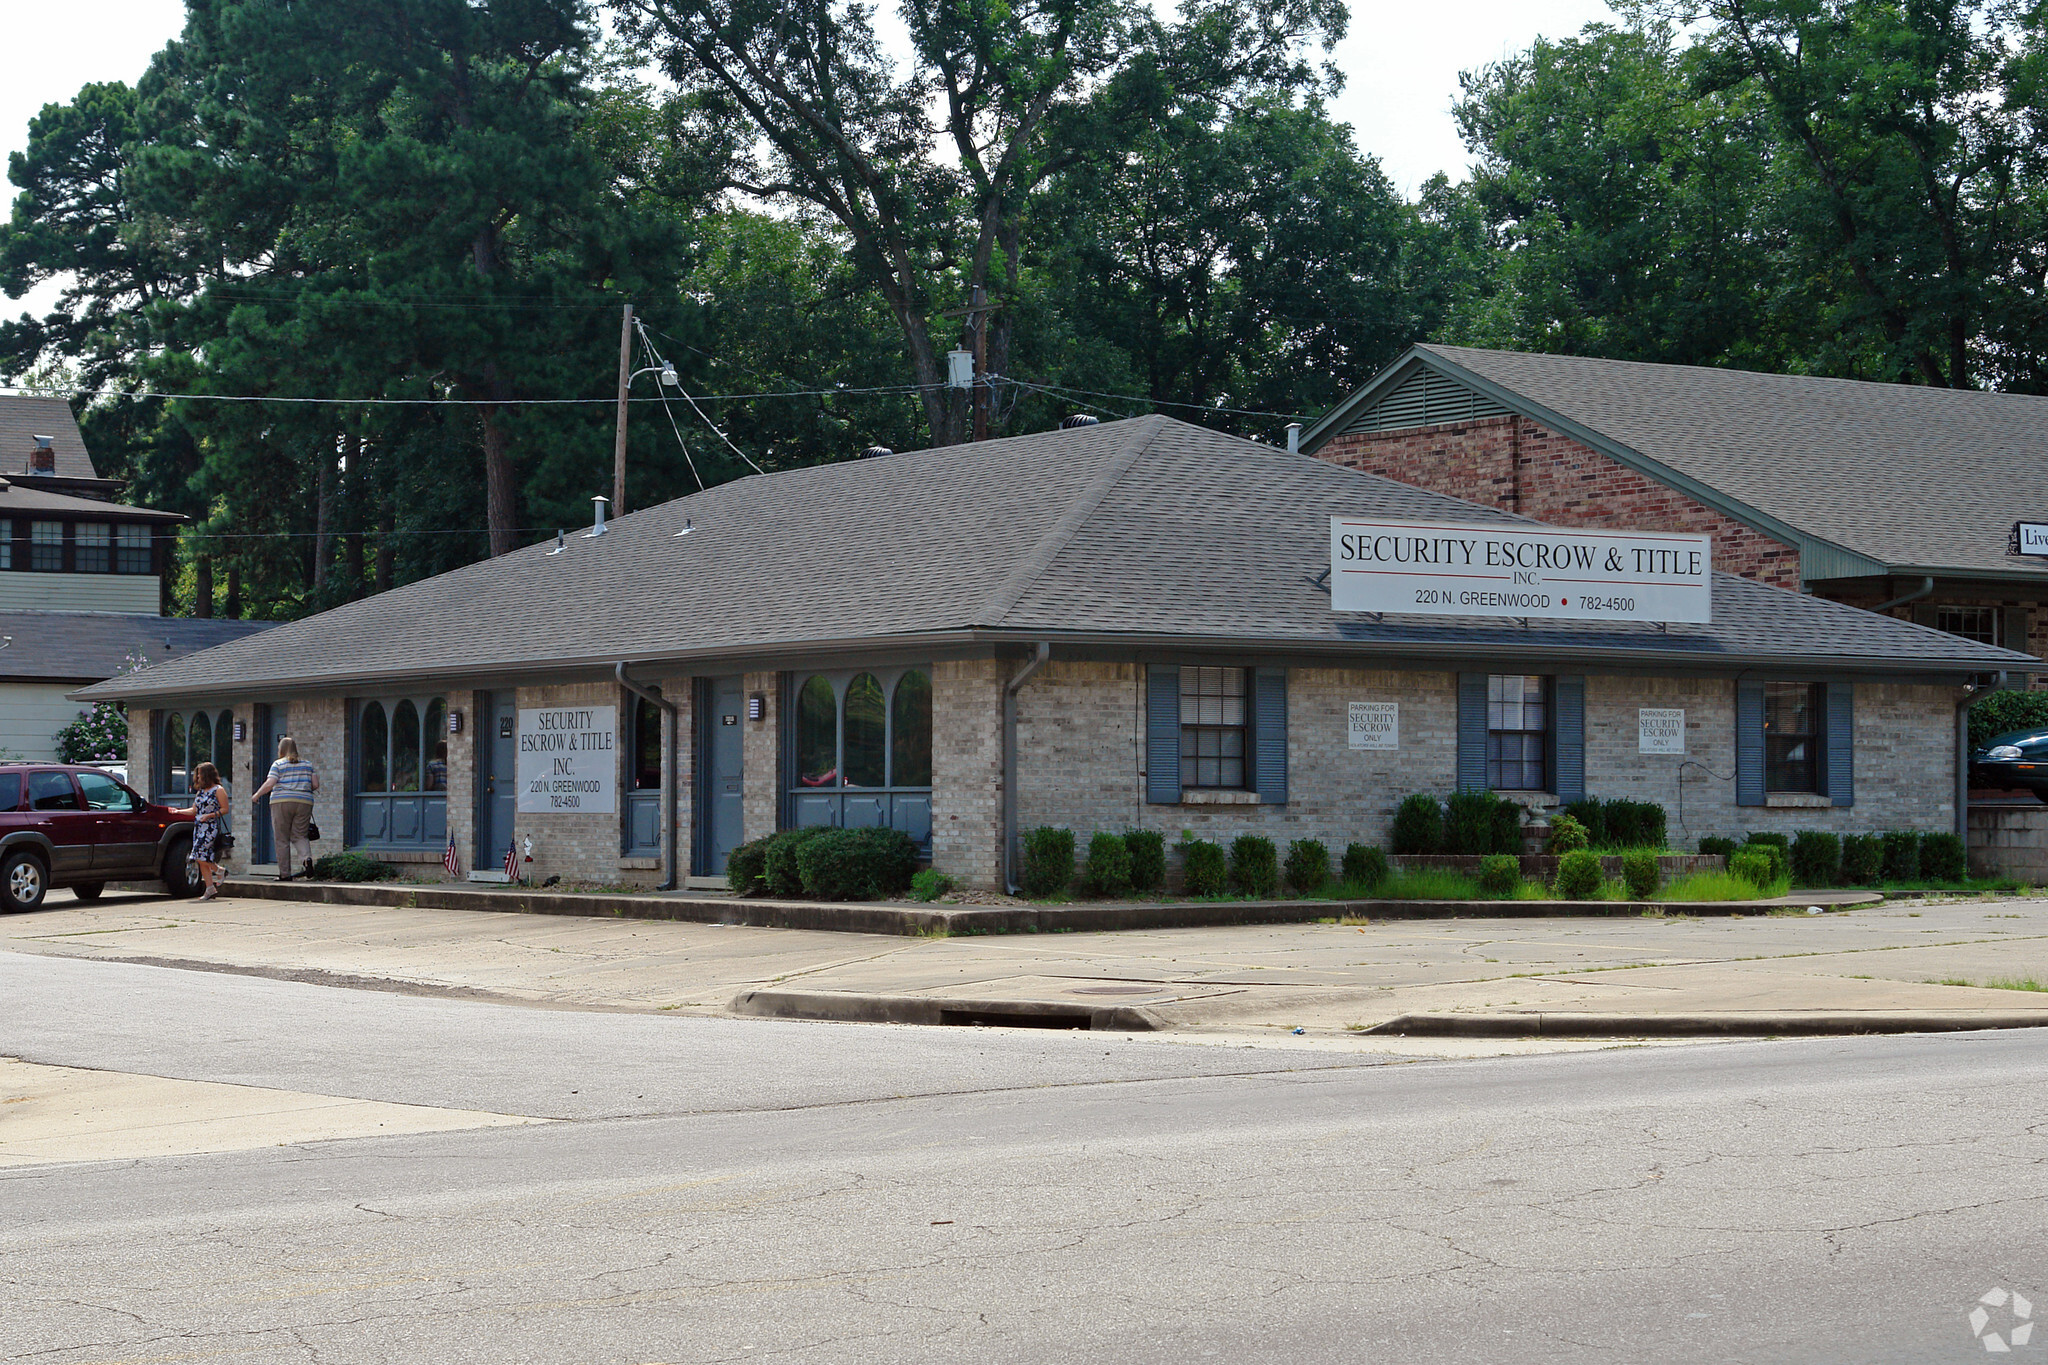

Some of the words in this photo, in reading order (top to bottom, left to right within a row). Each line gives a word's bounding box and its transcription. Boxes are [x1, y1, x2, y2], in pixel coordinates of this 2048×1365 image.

[1340, 534, 1477, 564] SECURITY
[1485, 541, 1597, 570] ESCROW
[1604, 547, 1624, 572] &
[1631, 548, 1703, 576] TITLE
[1513, 571, 1540, 586] INC.
[1415, 589, 1438, 604] 220
[1442, 591, 1456, 604] N.
[1459, 591, 1550, 608] GREENWOOD
[1579, 596, 1635, 611] 782-4500
[1380, 704, 1395, 712] FOR
[500, 716, 513, 729] 220
[538, 711, 594, 731] SECURITY
[1350, 714, 1395, 722] SECURITY
[1640, 719, 1681, 728] SECURITY
[1353, 723, 1392, 732] ESCROW
[1643, 728, 1679, 737] ESCROW
[521, 733, 567, 752] ESCROW
[569, 733, 577, 750] &
[580, 731, 612, 751] TITLE
[553, 757, 575, 776] INC.
[530, 780, 543, 793] 220
[552, 780, 601, 793] GREENWOOD
[550, 795, 580, 808] 782-4500
